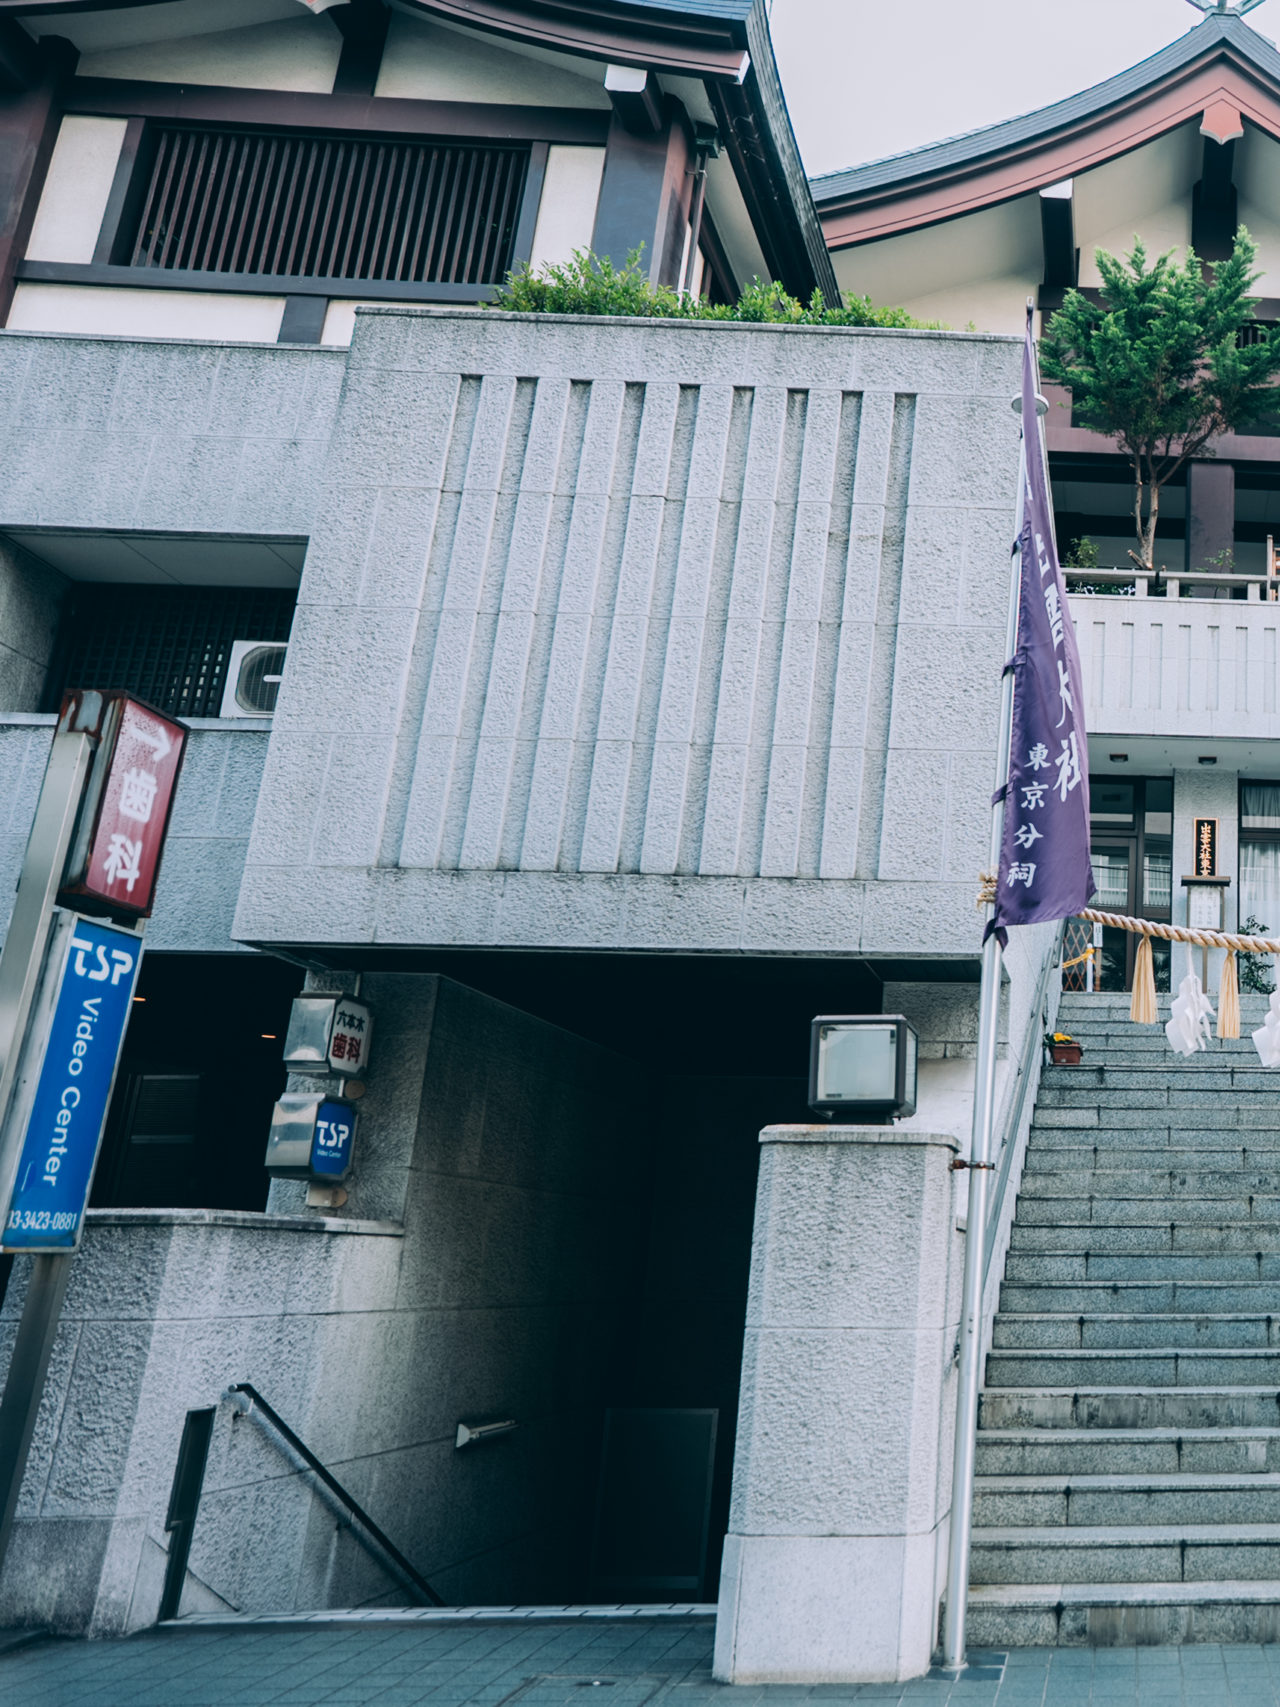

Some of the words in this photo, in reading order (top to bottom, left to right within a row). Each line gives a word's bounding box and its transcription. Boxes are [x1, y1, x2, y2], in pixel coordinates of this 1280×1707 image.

[103, 766, 158, 892] 歯科
[1006, 742, 1051, 889] 東京分祠
[70, 936, 134, 986] TSP
[67, 996, 102, 1076] Video
[331, 1032, 362, 1064] 歯科
[336, 1010, 366, 1033] 六本木
[42, 1086, 81, 1187] Center
[316, 1120, 349, 1148] TSP
